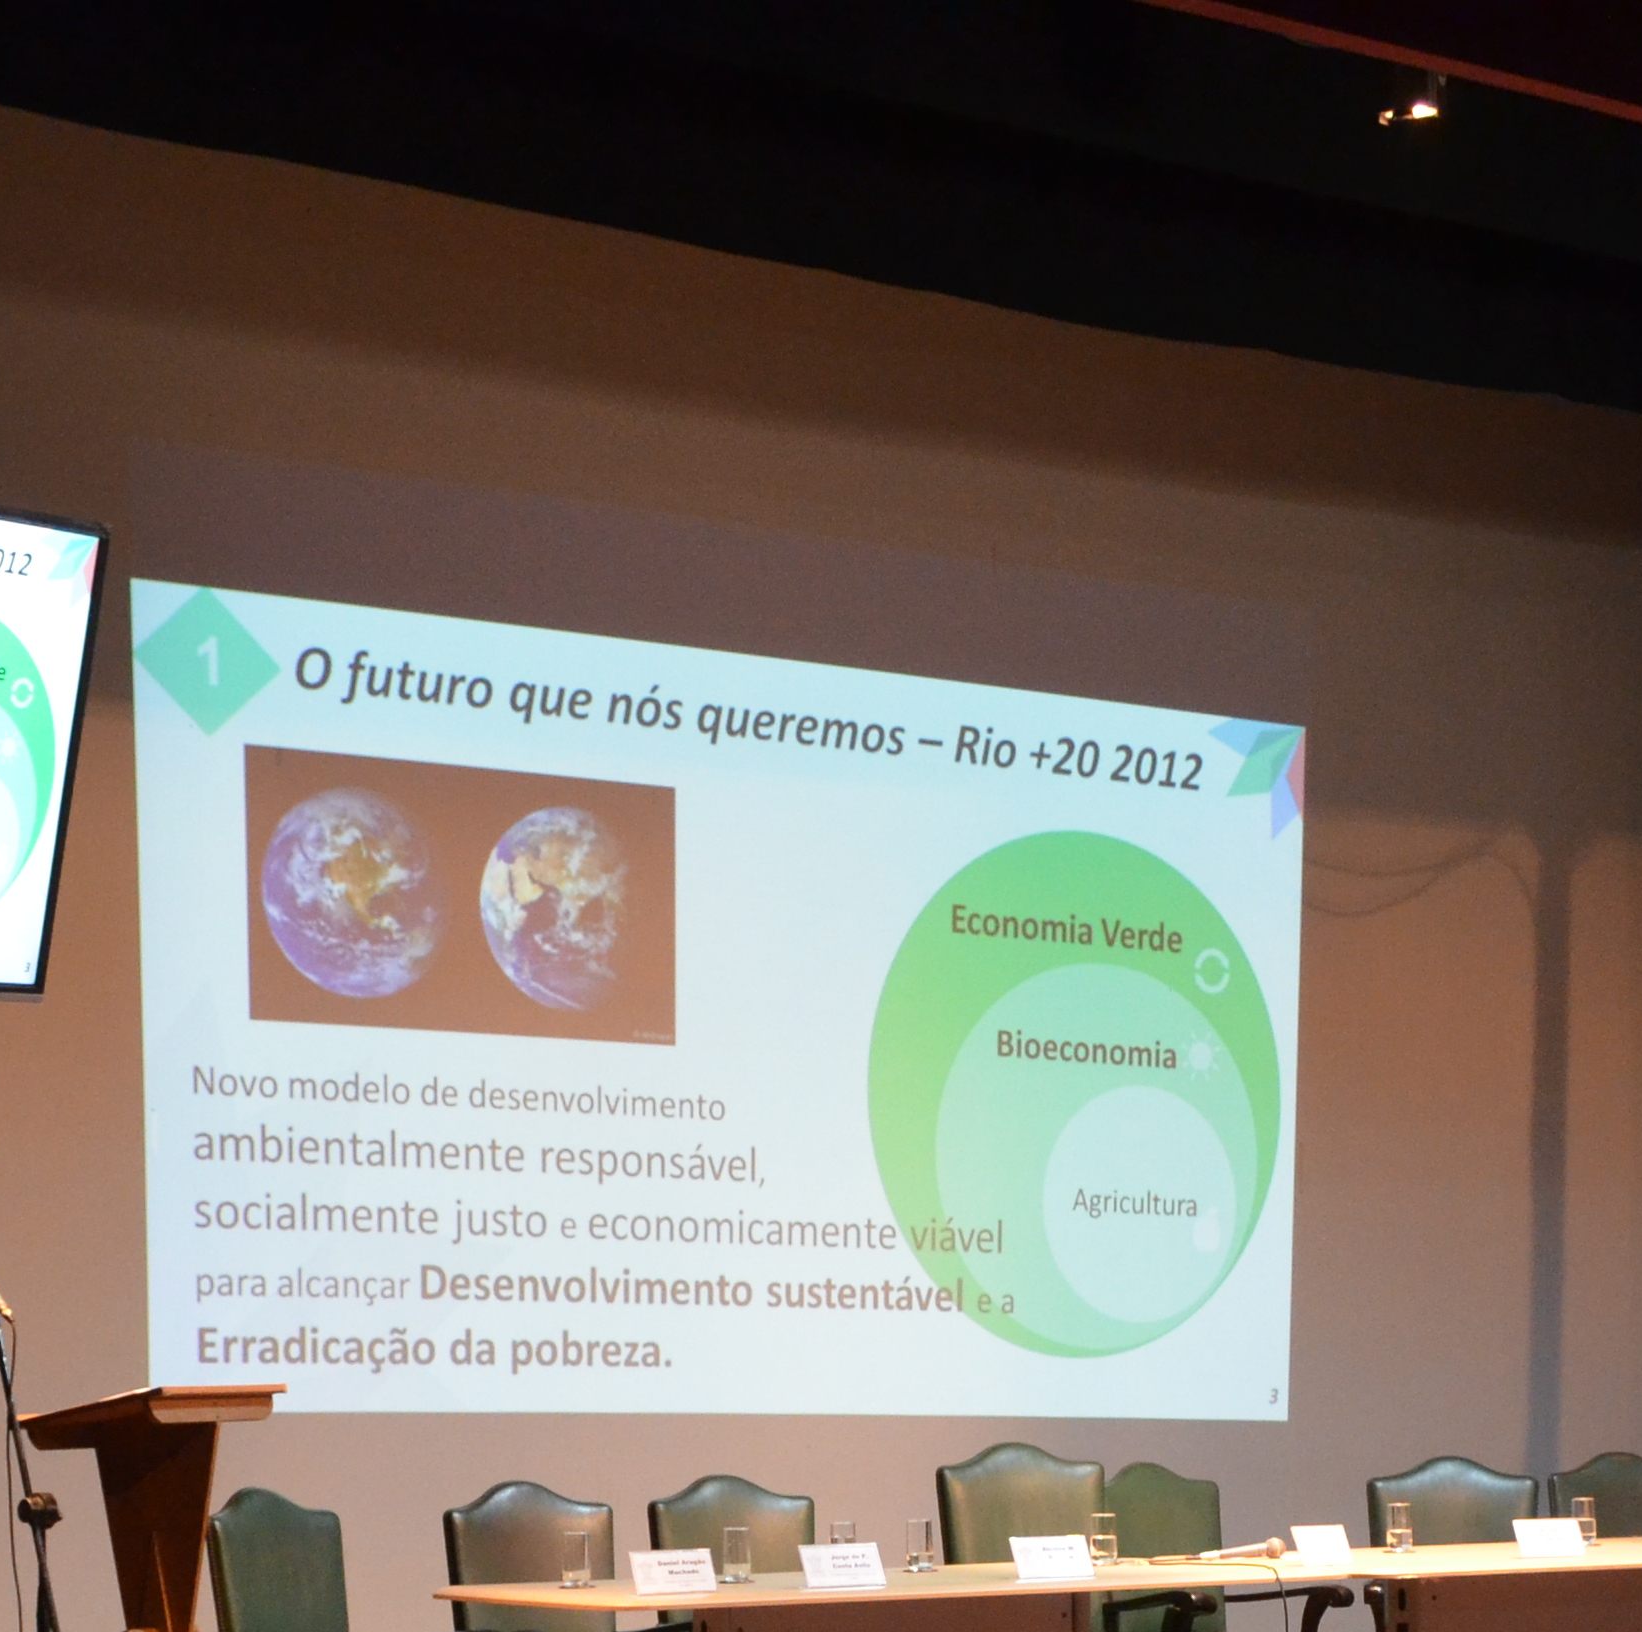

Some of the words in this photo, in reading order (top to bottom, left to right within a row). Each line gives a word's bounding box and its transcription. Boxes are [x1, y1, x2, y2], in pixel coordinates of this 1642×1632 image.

[198, 637, 220, 685] 1
[294, 646, 333, 691] O
[340, 649, 494, 709] futuro
[509, 681, 593, 725] que
[606, 684, 684, 731] nós
[696, 703, 906, 756] queremos
[954, 724, 1017, 769] Rio
[1029, 736, 1101, 779] +20
[1109, 743, 1204, 792] 2012
[951, 903, 1093, 946] Economia
[1100, 917, 1183, 954] Verde
[996, 1028, 1178, 1070] Bioeconomia
[192, 1064, 279, 1099] Novo
[288, 1071, 411, 1105] modelo
[420, 1075, 459, 1108] de
[468, 1078, 726, 1122] desenvolvimento
[193, 1122, 525, 1173] ambientalmente
[540, 1143, 765, 1188] responsável,
[194, 1191, 439, 1236] socialmente
[451, 1198, 548, 1246] justo
[560, 1217, 577, 1240] e
[588, 1209, 897, 1251] economicamente
[910, 1216, 1003, 1254] viável
[1071, 1187, 1198, 1220] Agricultura
[195, 1271, 267, 1304] para
[276, 1266, 411, 1307] alcançar
[419, 1263, 753, 1308] Desenvolvimento
[766, 1275, 965, 1313] sustentável
[975, 1292, 993, 1315] e
[1000, 1293, 1015, 1315] a
[197, 1325, 436, 1375] Erradicação
[449, 1327, 496, 1366] da
[511, 1329, 672, 1376] pobreza.
[1268, 1387, 1279, 1406] 3
